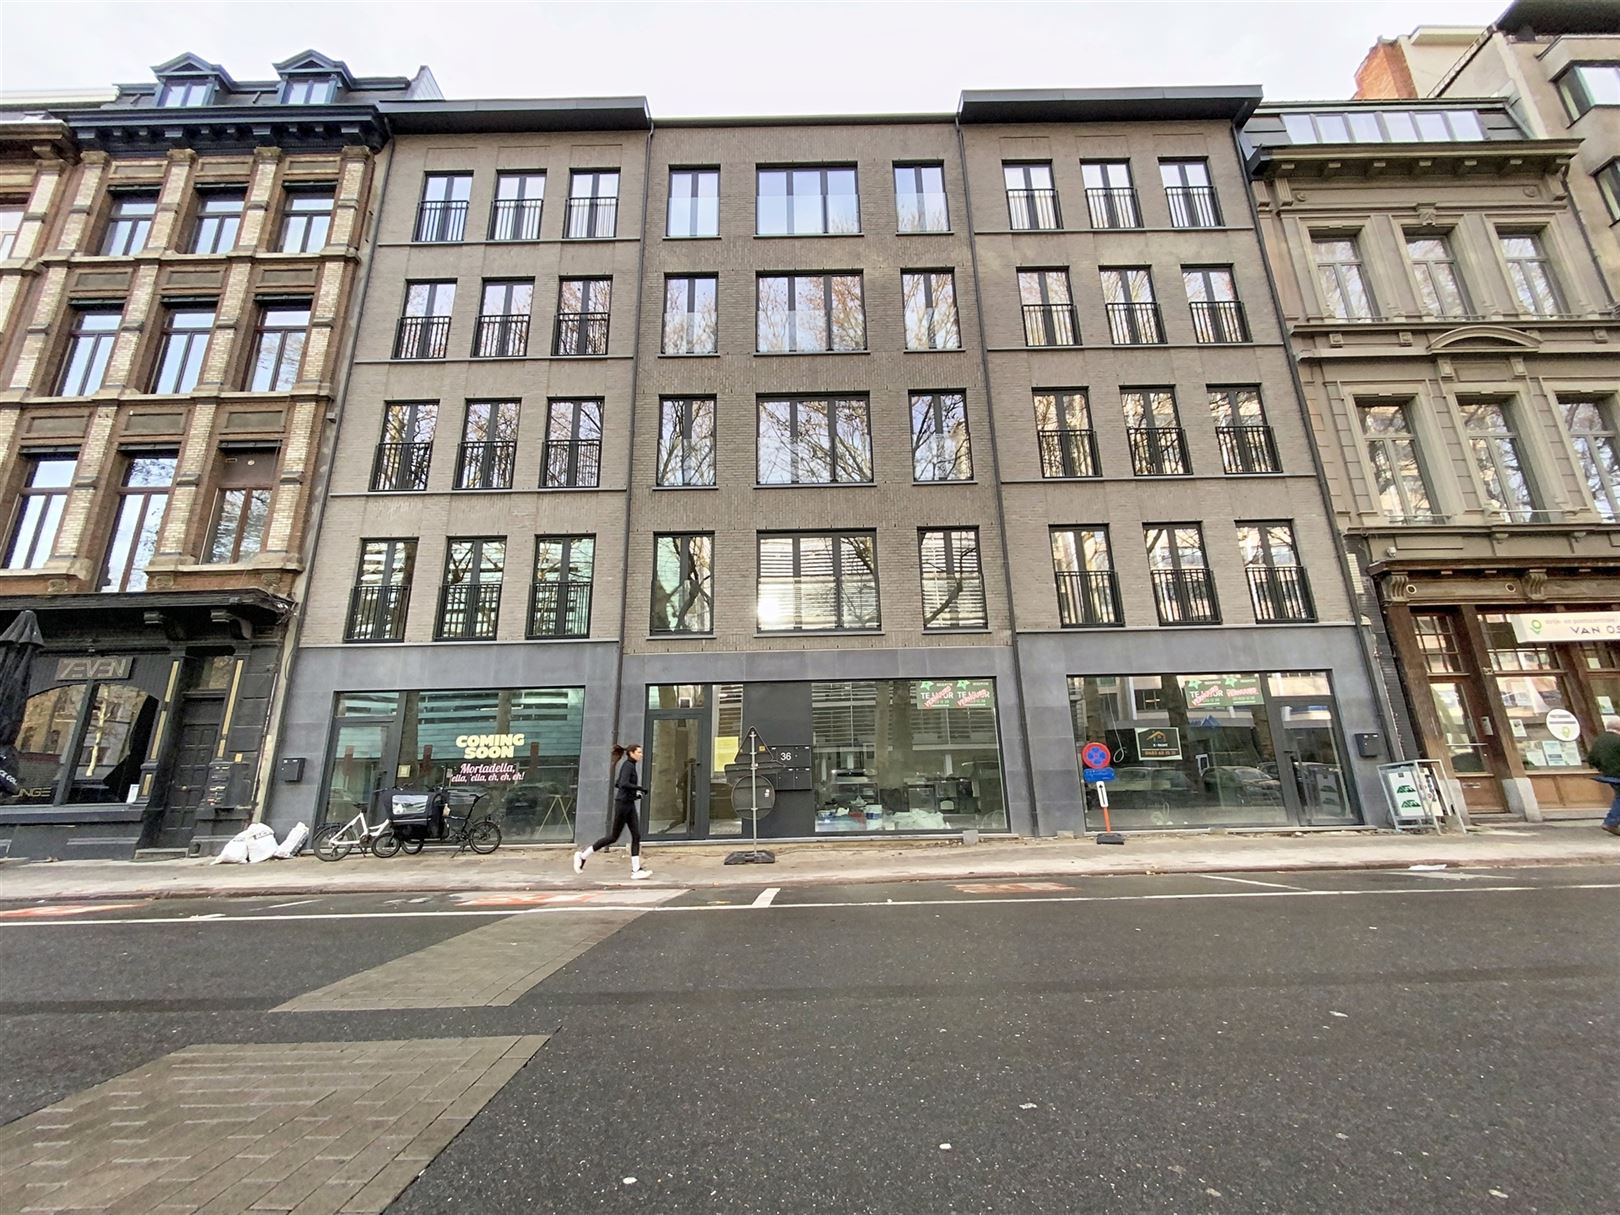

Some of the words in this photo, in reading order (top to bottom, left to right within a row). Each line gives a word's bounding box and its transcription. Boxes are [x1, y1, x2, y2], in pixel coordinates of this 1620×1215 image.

[1569, 626, 1600, 635] VAN
[455, 733, 525, 748] COMING
[463, 745, 514, 759] SOON
[780, 752, 792, 761] 36
[460, 762, 516, 774] Mortadella,
